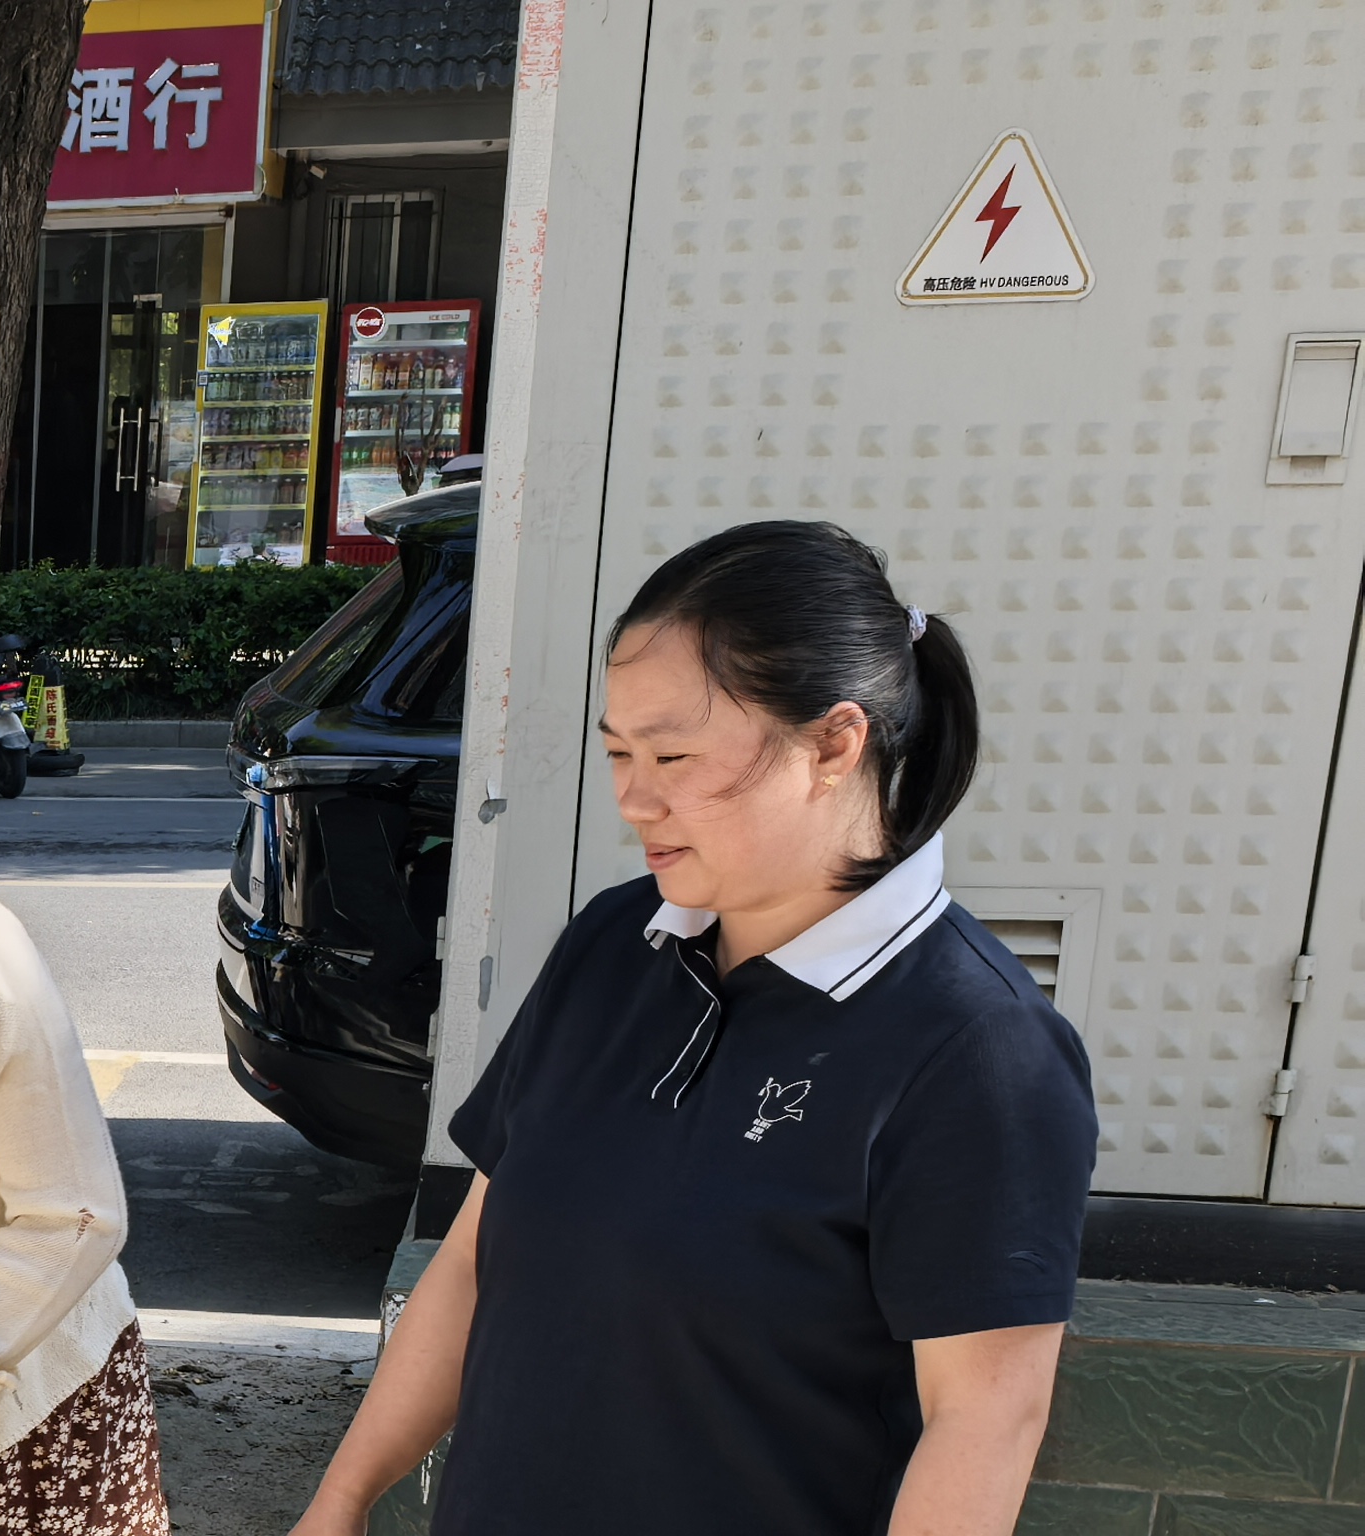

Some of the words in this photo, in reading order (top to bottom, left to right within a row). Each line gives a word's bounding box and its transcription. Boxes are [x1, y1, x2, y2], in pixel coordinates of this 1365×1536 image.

[923, 276, 977, 292] 高压危险
[980, 277, 996, 288] HV
[997, 275, 1069, 288] DANGEROUS
